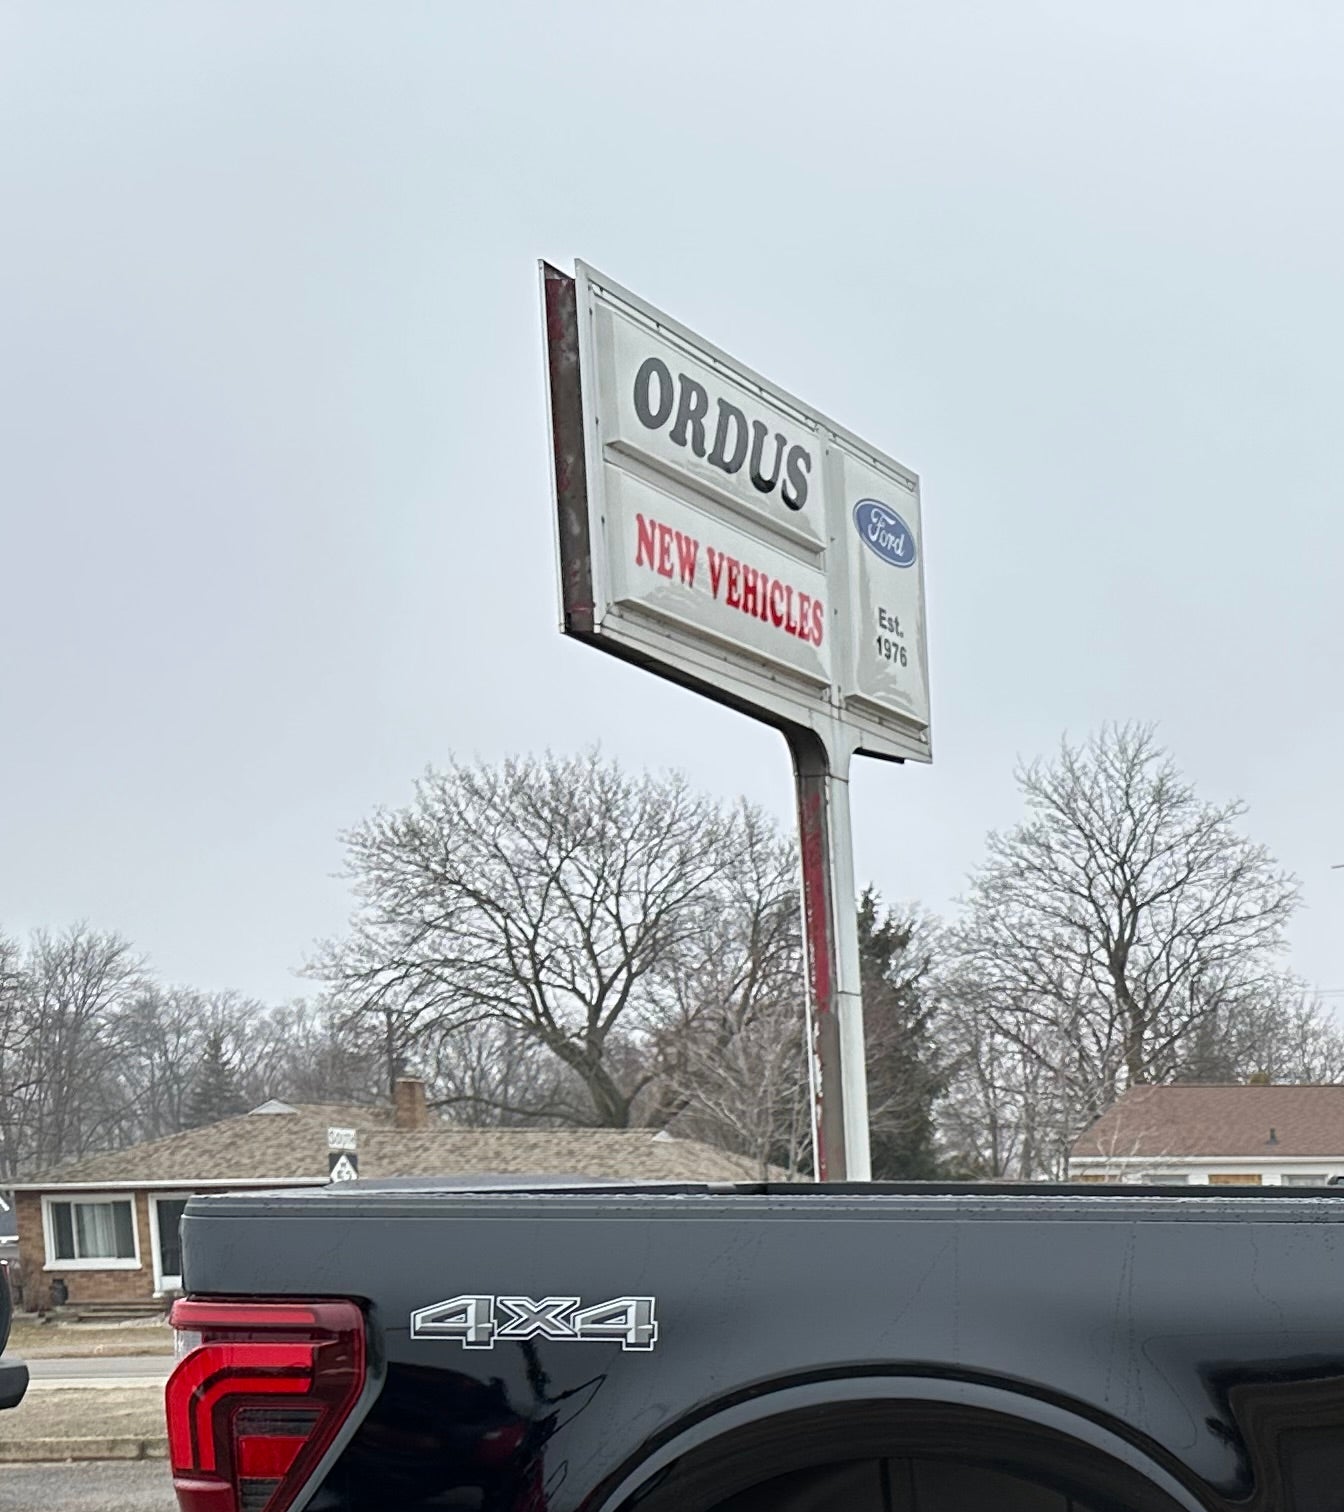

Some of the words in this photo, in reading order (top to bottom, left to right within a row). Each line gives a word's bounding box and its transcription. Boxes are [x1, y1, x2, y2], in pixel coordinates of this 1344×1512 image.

[633, 357, 812, 512] ORDUS
[867, 507, 905, 558] Ford
[635, 512, 700, 588] NEW
[706, 546, 825, 648] VEHICLES
[878, 606, 904, 638] Est.
[876, 635, 908, 668] 1976
[410, 1294, 659, 1351] 4X4
